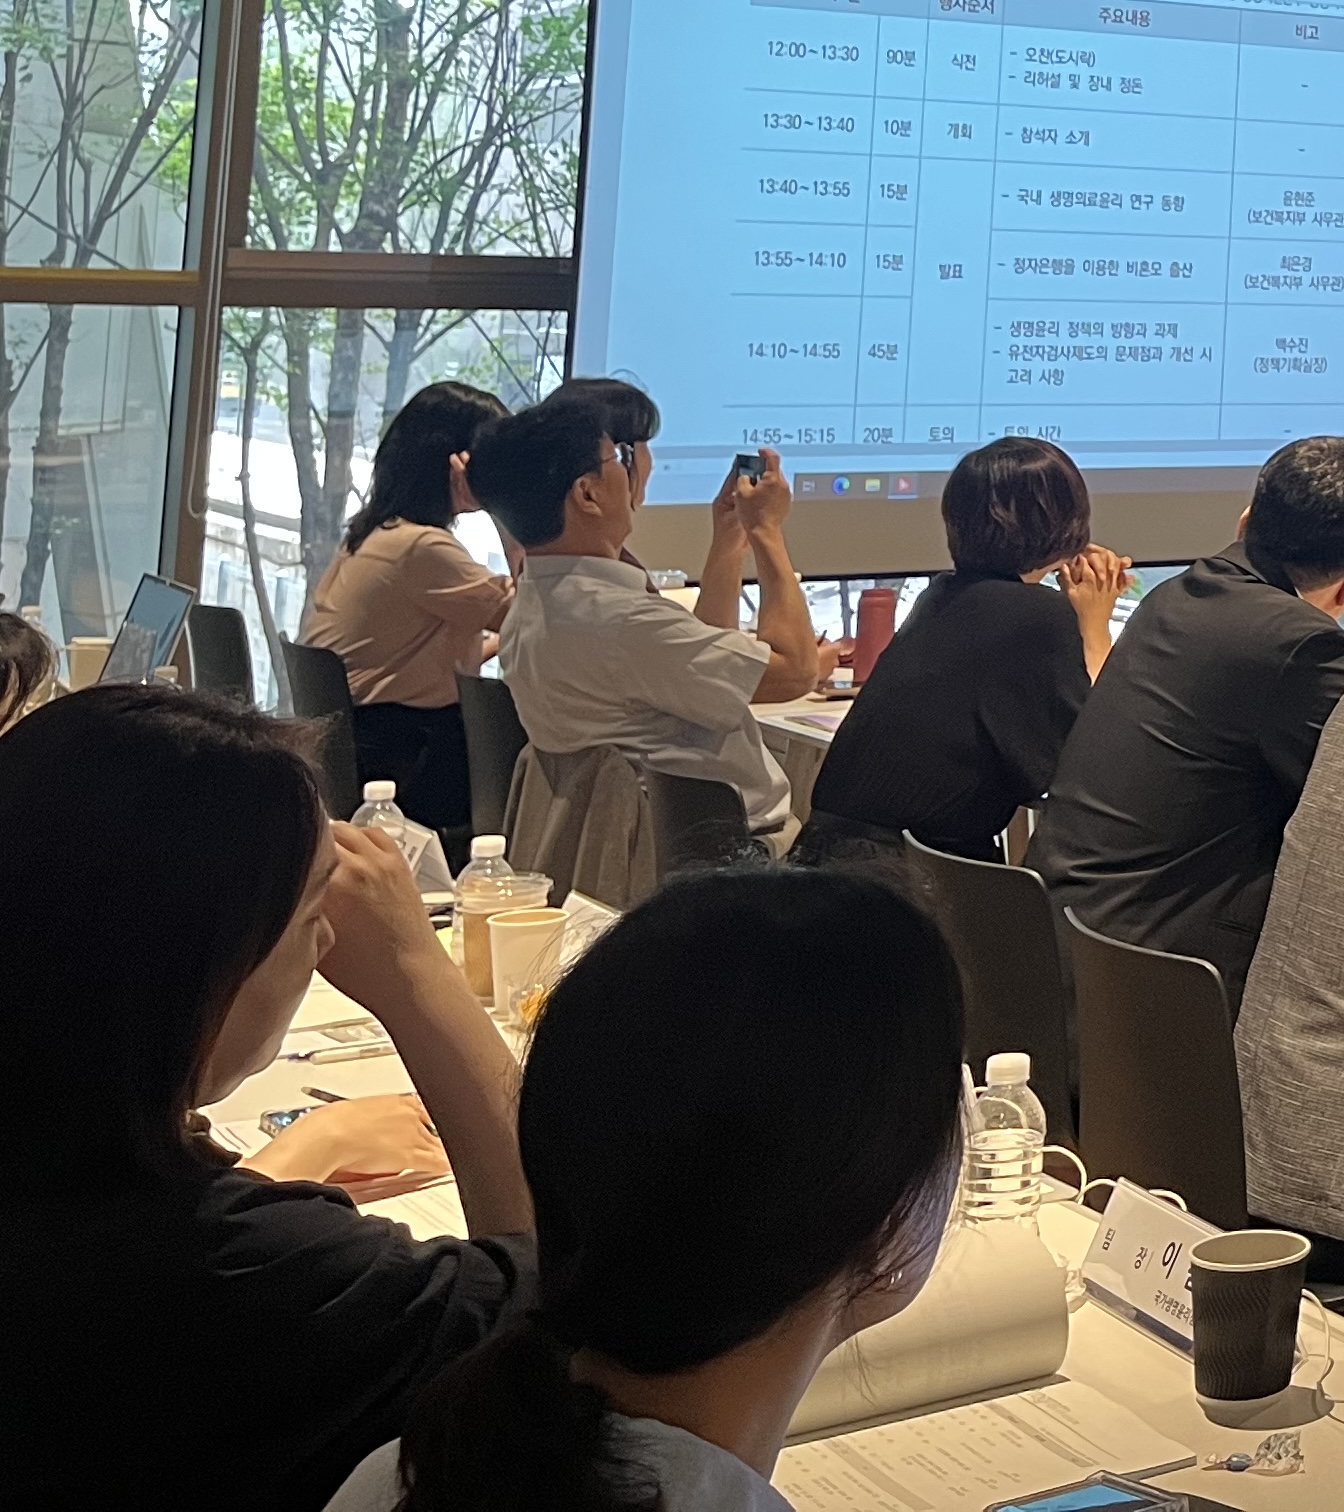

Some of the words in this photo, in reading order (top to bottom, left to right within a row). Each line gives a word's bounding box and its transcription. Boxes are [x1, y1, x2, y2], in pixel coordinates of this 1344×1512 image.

[1098, 7, 1151, 28] 주요내용
[1295, 24, 1320, 40] 비고
[767, 40, 860, 62] 12:00~13:30
[886, 48, 916, 68] 90분
[1024, 47, 1096, 68] 오찬(도시락)
[951, 53, 977, 72] 식전
[1023, 70, 1062, 89] 리허설
[1068, 73, 1081, 90] 및
[1087, 74, 1113, 92] 장내
[1119, 76, 1143, 95] 정돈
[763, 113, 855, 133] 13:30~13:40
[883, 119, 912, 138] 10분
[947, 123, 973, 140] 개회
[1020, 126, 1058, 145] 참석자
[1064, 130, 1090, 147] 소개
[758, 177, 851, 198] 13:40~13:55
[879, 183, 908, 201] 15분
[1016, 188, 1043, 206] 국내
[1049, 190, 1123, 209] 생명의료윤리
[1129, 193, 1154, 211] 연구
[1161, 194, 1185, 213] 동향
[754, 250, 847, 269] 13:55~14:10
[875, 253, 904, 272] 15분
[1013, 257, 1076, 276] 정자은행을
[1082, 259, 1120, 277] 이용한
[1126, 260, 1163, 278] 비혼모
[1169, 261, 1194, 279] 출산
[1009, 320, 1060, 338] 생명윤리
[1067, 321, 1105, 339] 정책의
[1110, 322, 1148, 340] 방향과
[1153, 322, 1179, 339] 과제
[748, 342, 841, 359] 14:10~14:55
[867, 343, 899, 361] 45분
[1007, 343, 1108, 362] 유전자검사제도의
[1114, 345, 1163, 363] 문제점과
[1169, 346, 1194, 363] 개선
[1199, 346, 1212, 363] 시
[1006, 368, 1032, 386] 고려
[1038, 368, 1065, 387] 사항
[742, 427, 836, 445] 14:55~15:15
[863, 427, 894, 444] 20분
[928, 426, 955, 444] 토의
